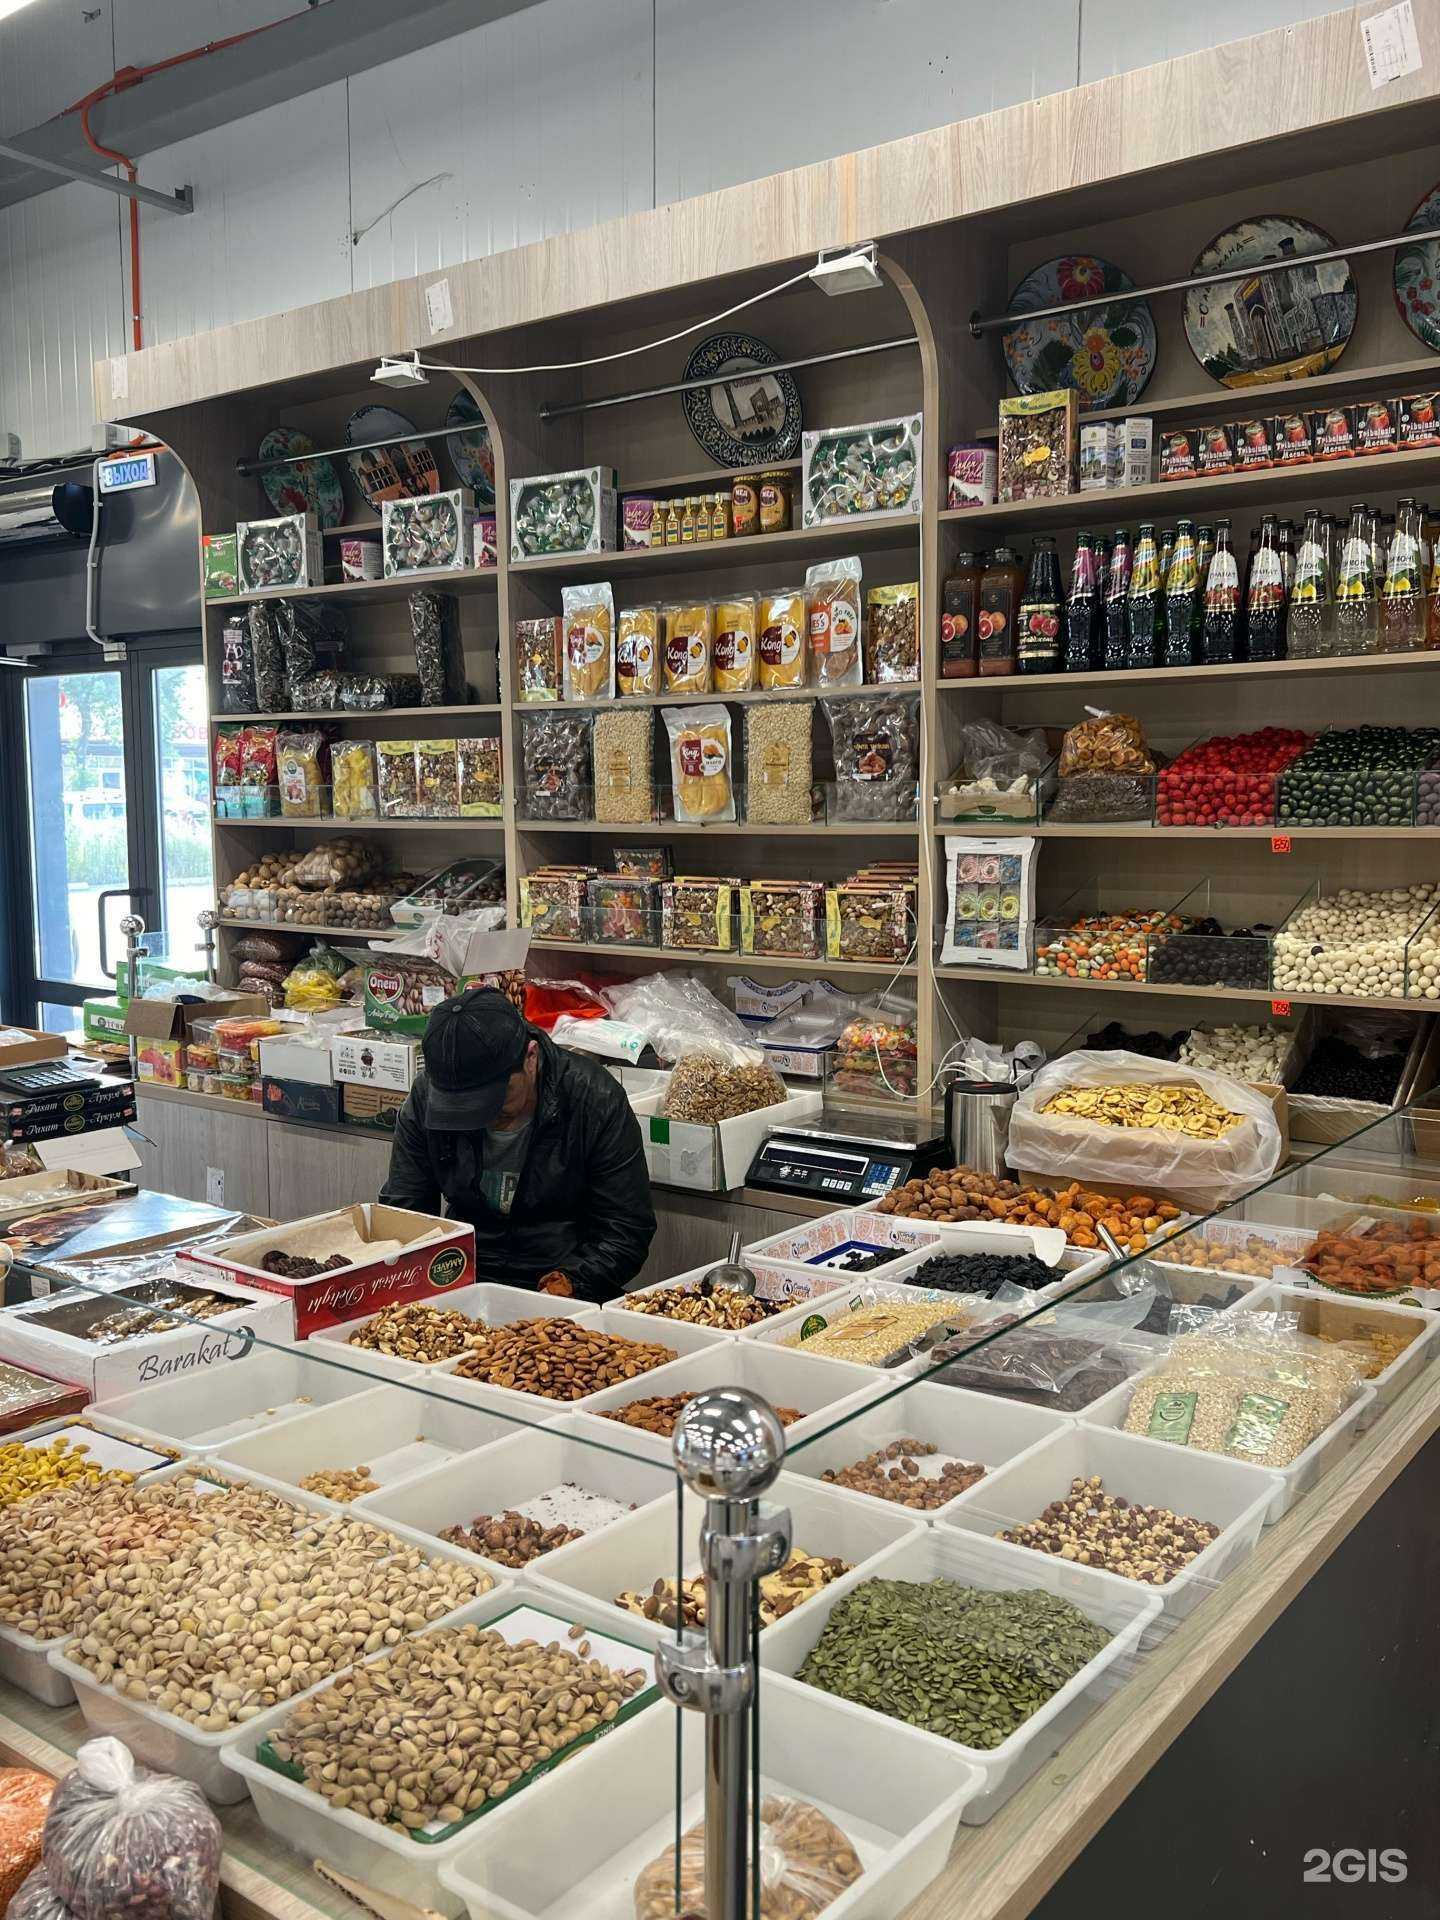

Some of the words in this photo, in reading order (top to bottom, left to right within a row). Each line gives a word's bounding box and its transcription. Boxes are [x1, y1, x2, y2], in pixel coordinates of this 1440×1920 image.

[105, 460, 148, 487] ВЫХОД
[371, 1265, 423, 1295] Turkish
[307, 1283, 366, 1313] Delight
[138, 1333, 232, 1383] Barakat
